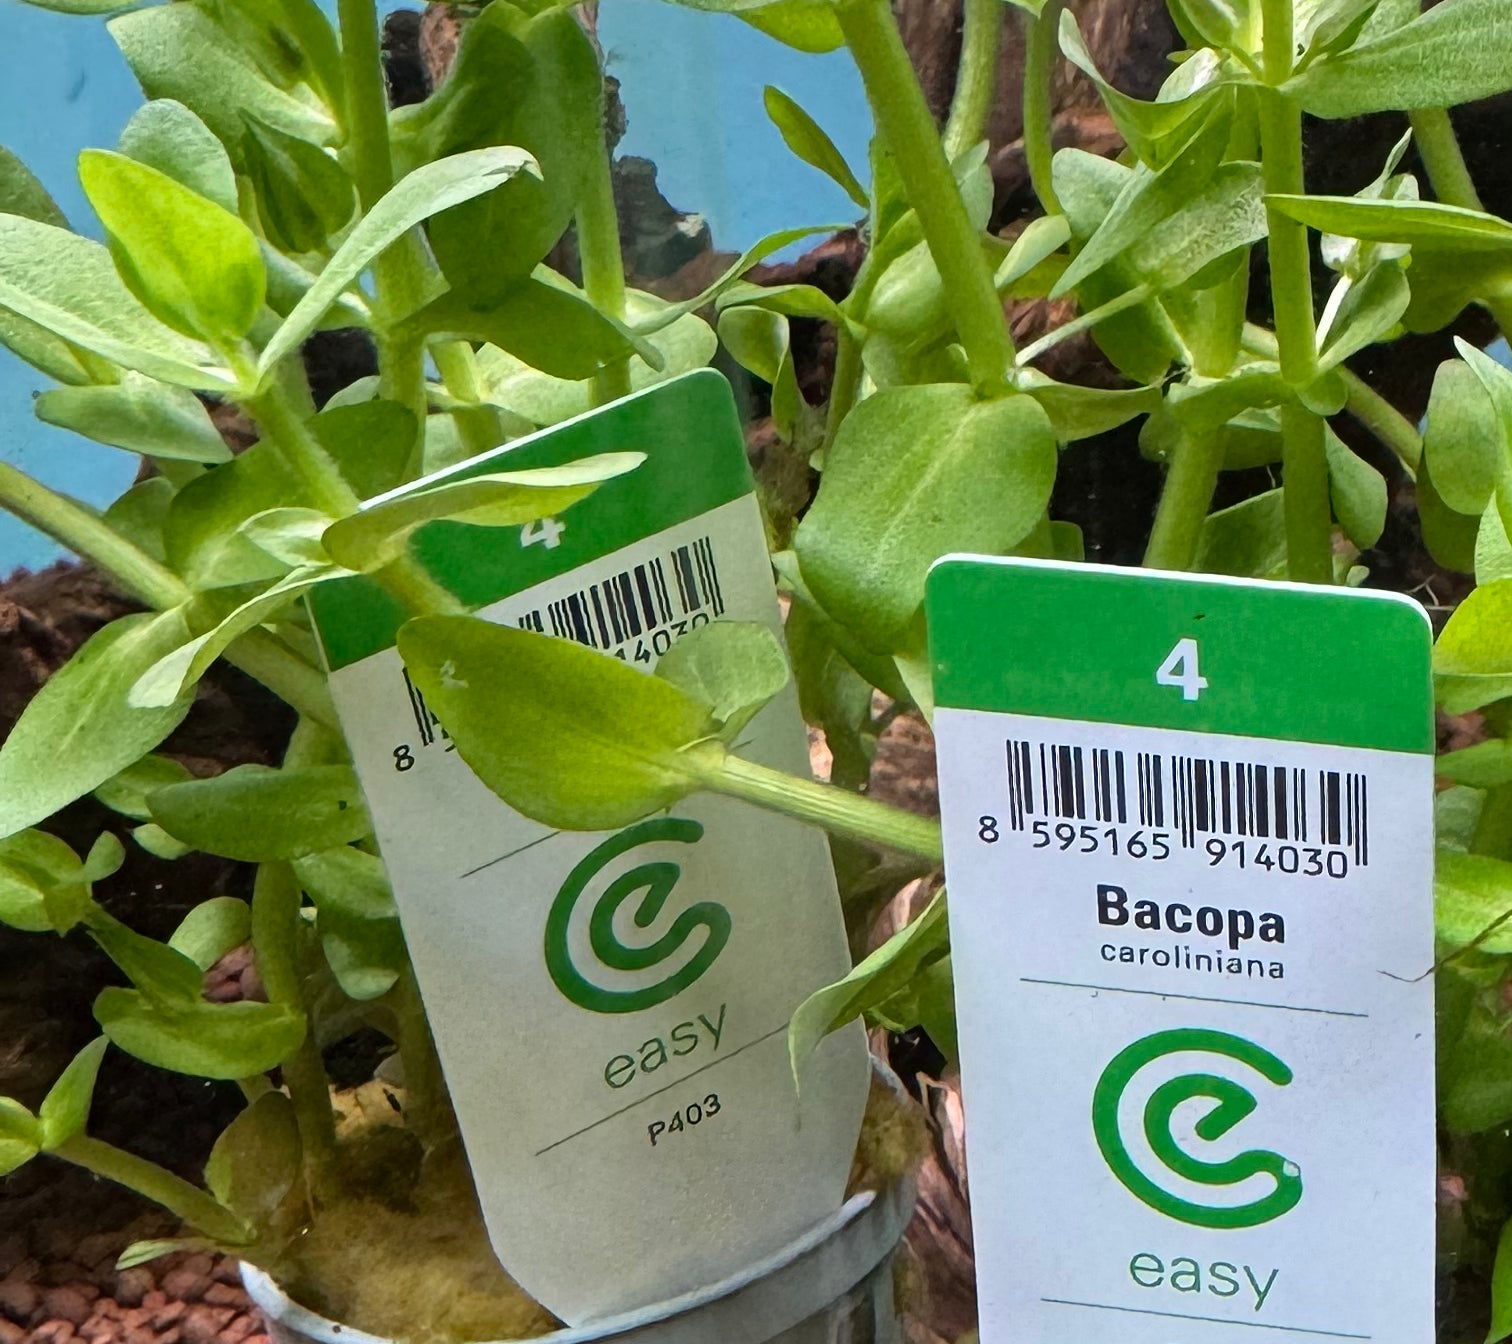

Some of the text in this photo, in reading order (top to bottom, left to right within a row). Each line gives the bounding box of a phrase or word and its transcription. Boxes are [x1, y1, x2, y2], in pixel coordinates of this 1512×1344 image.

[520, 516, 566, 550] 4
[1155, 638, 1209, 701] 4
[393, 744, 415, 772] 8
[978, 815, 1350, 880] 8 595165 914030
[1096, 883, 1286, 950] Bacopa
[1100, 941, 1286, 979] caroliniana
[604, 1002, 727, 1090] easy
[646, 1092, 722, 1147] P403
[1129, 1252, 1280, 1313] easy
